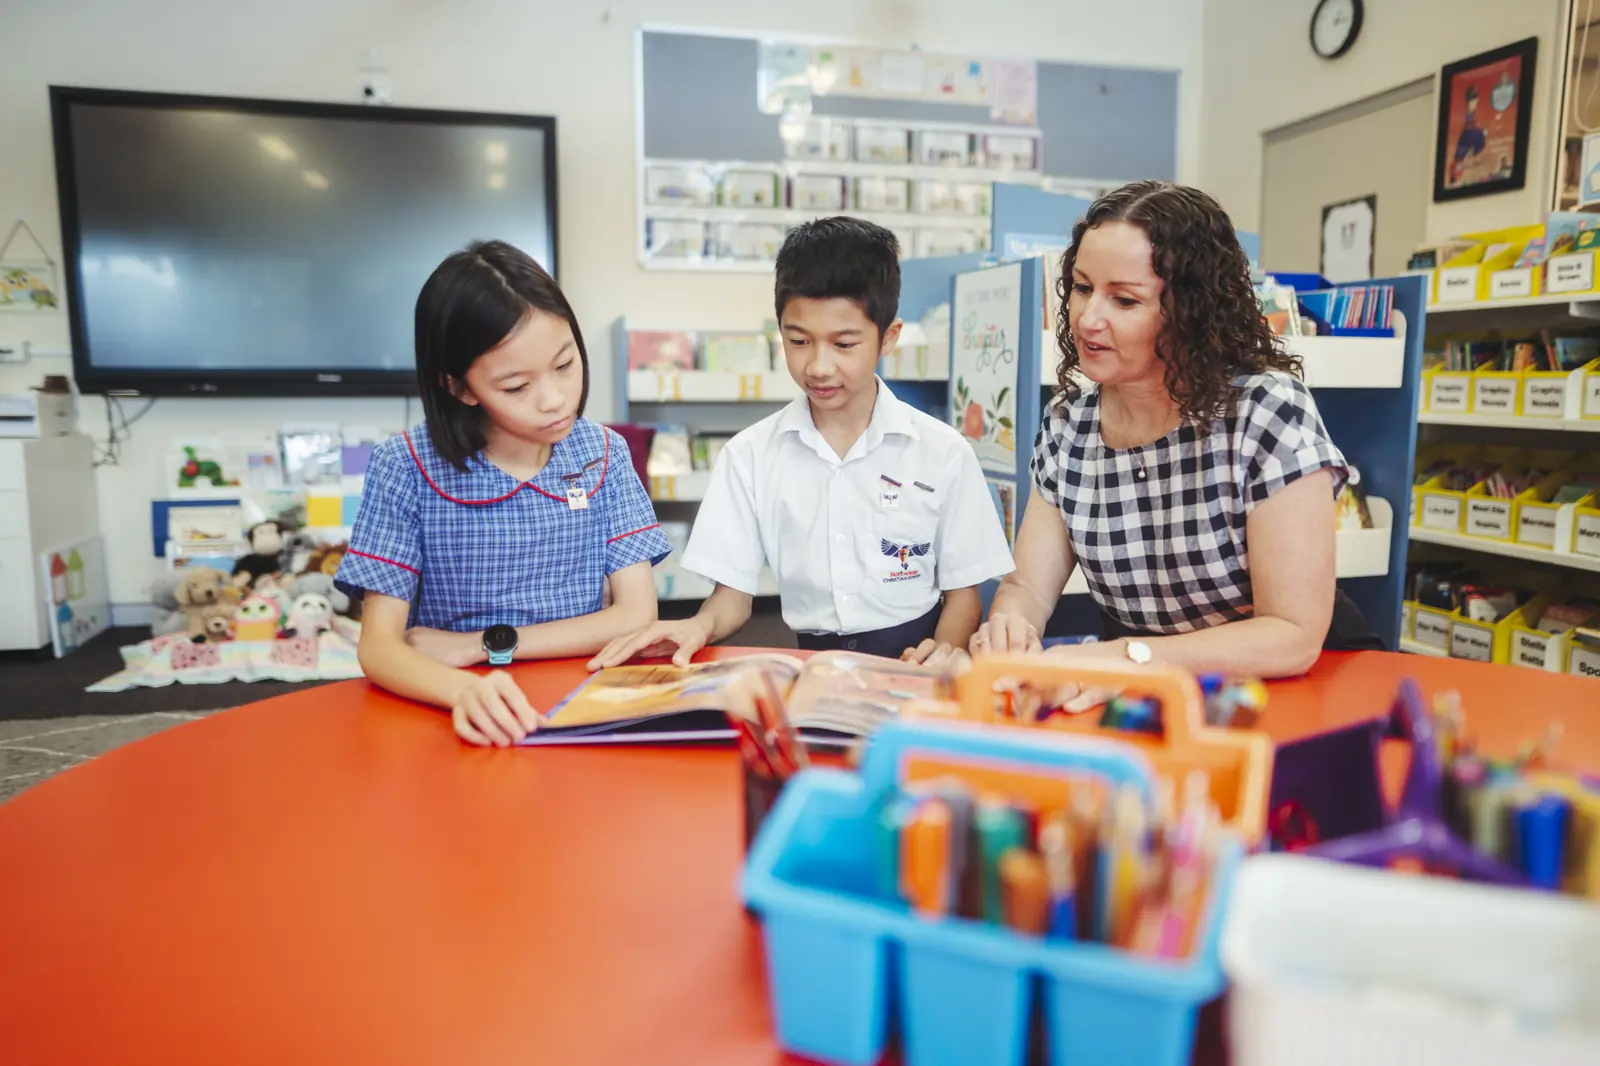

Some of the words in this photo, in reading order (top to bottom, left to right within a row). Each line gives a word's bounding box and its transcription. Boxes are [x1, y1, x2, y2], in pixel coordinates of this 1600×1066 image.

[1480, 384, 1511, 396] Graphic
[1530, 384, 1563, 396] Graphic
[1531, 399, 1561, 409] Novels
